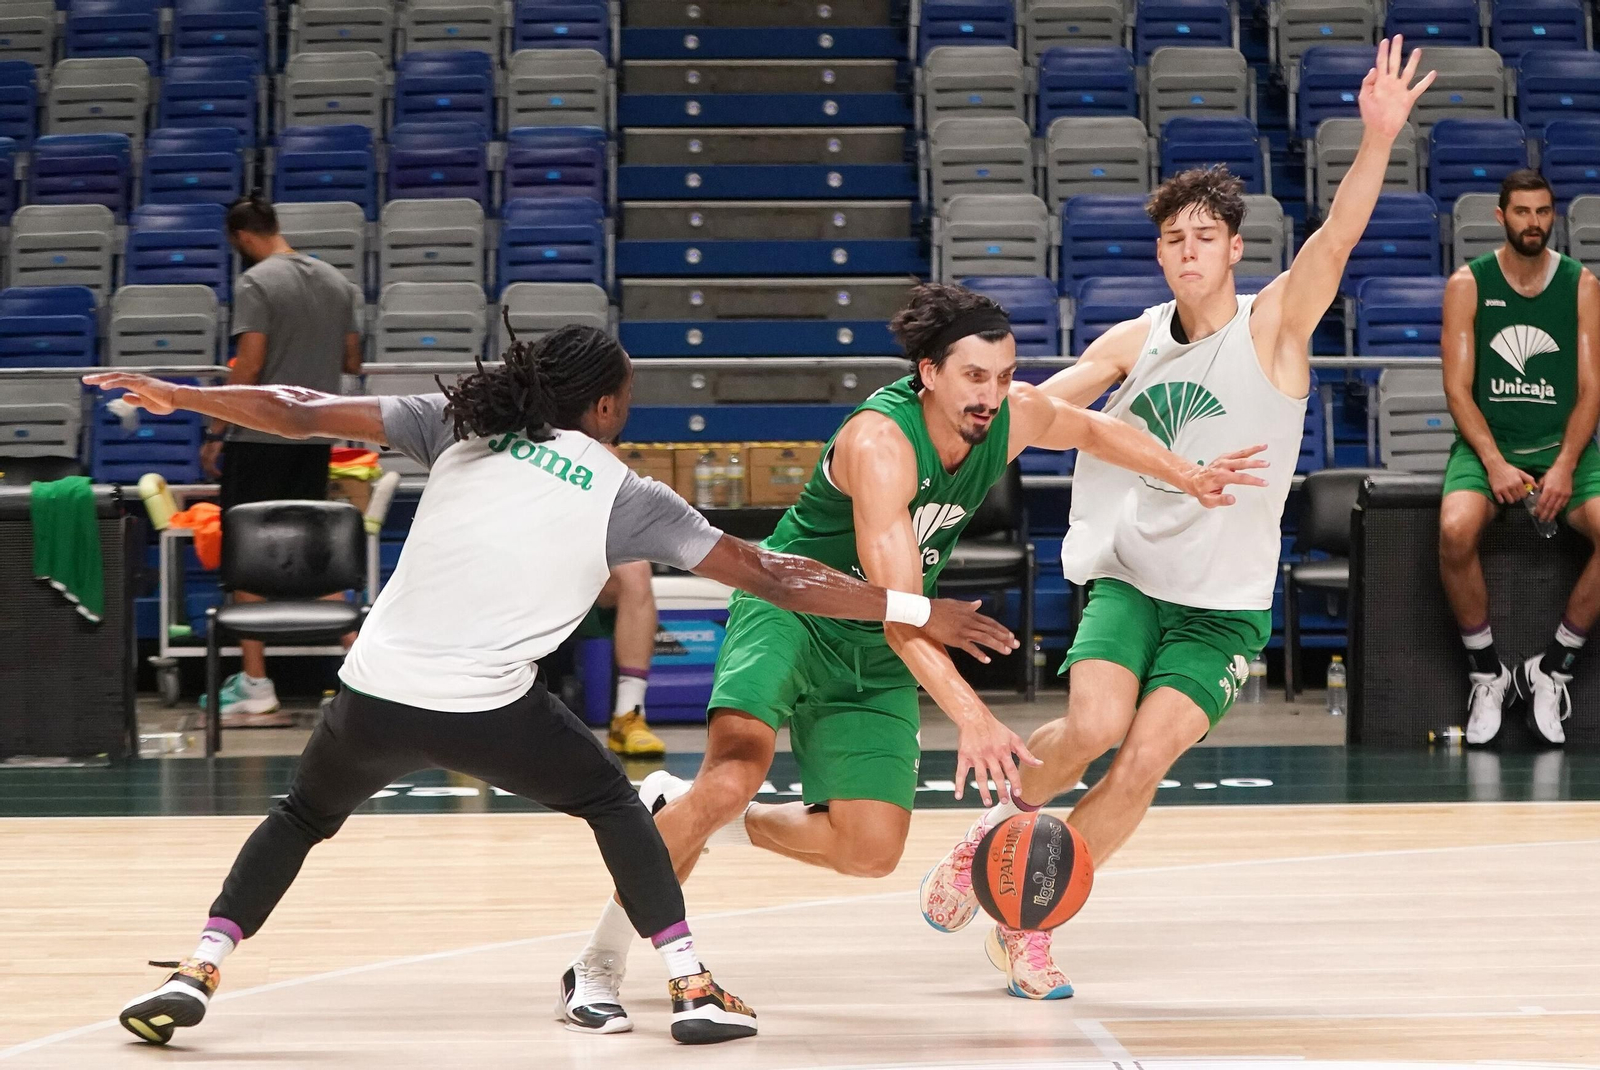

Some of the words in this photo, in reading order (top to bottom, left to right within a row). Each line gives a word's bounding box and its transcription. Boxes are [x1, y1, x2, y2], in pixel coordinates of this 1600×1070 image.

[1491, 377, 1555, 399] Unicaja
[488, 431, 594, 491] Joma
[999, 820, 1031, 897] SPALDING
